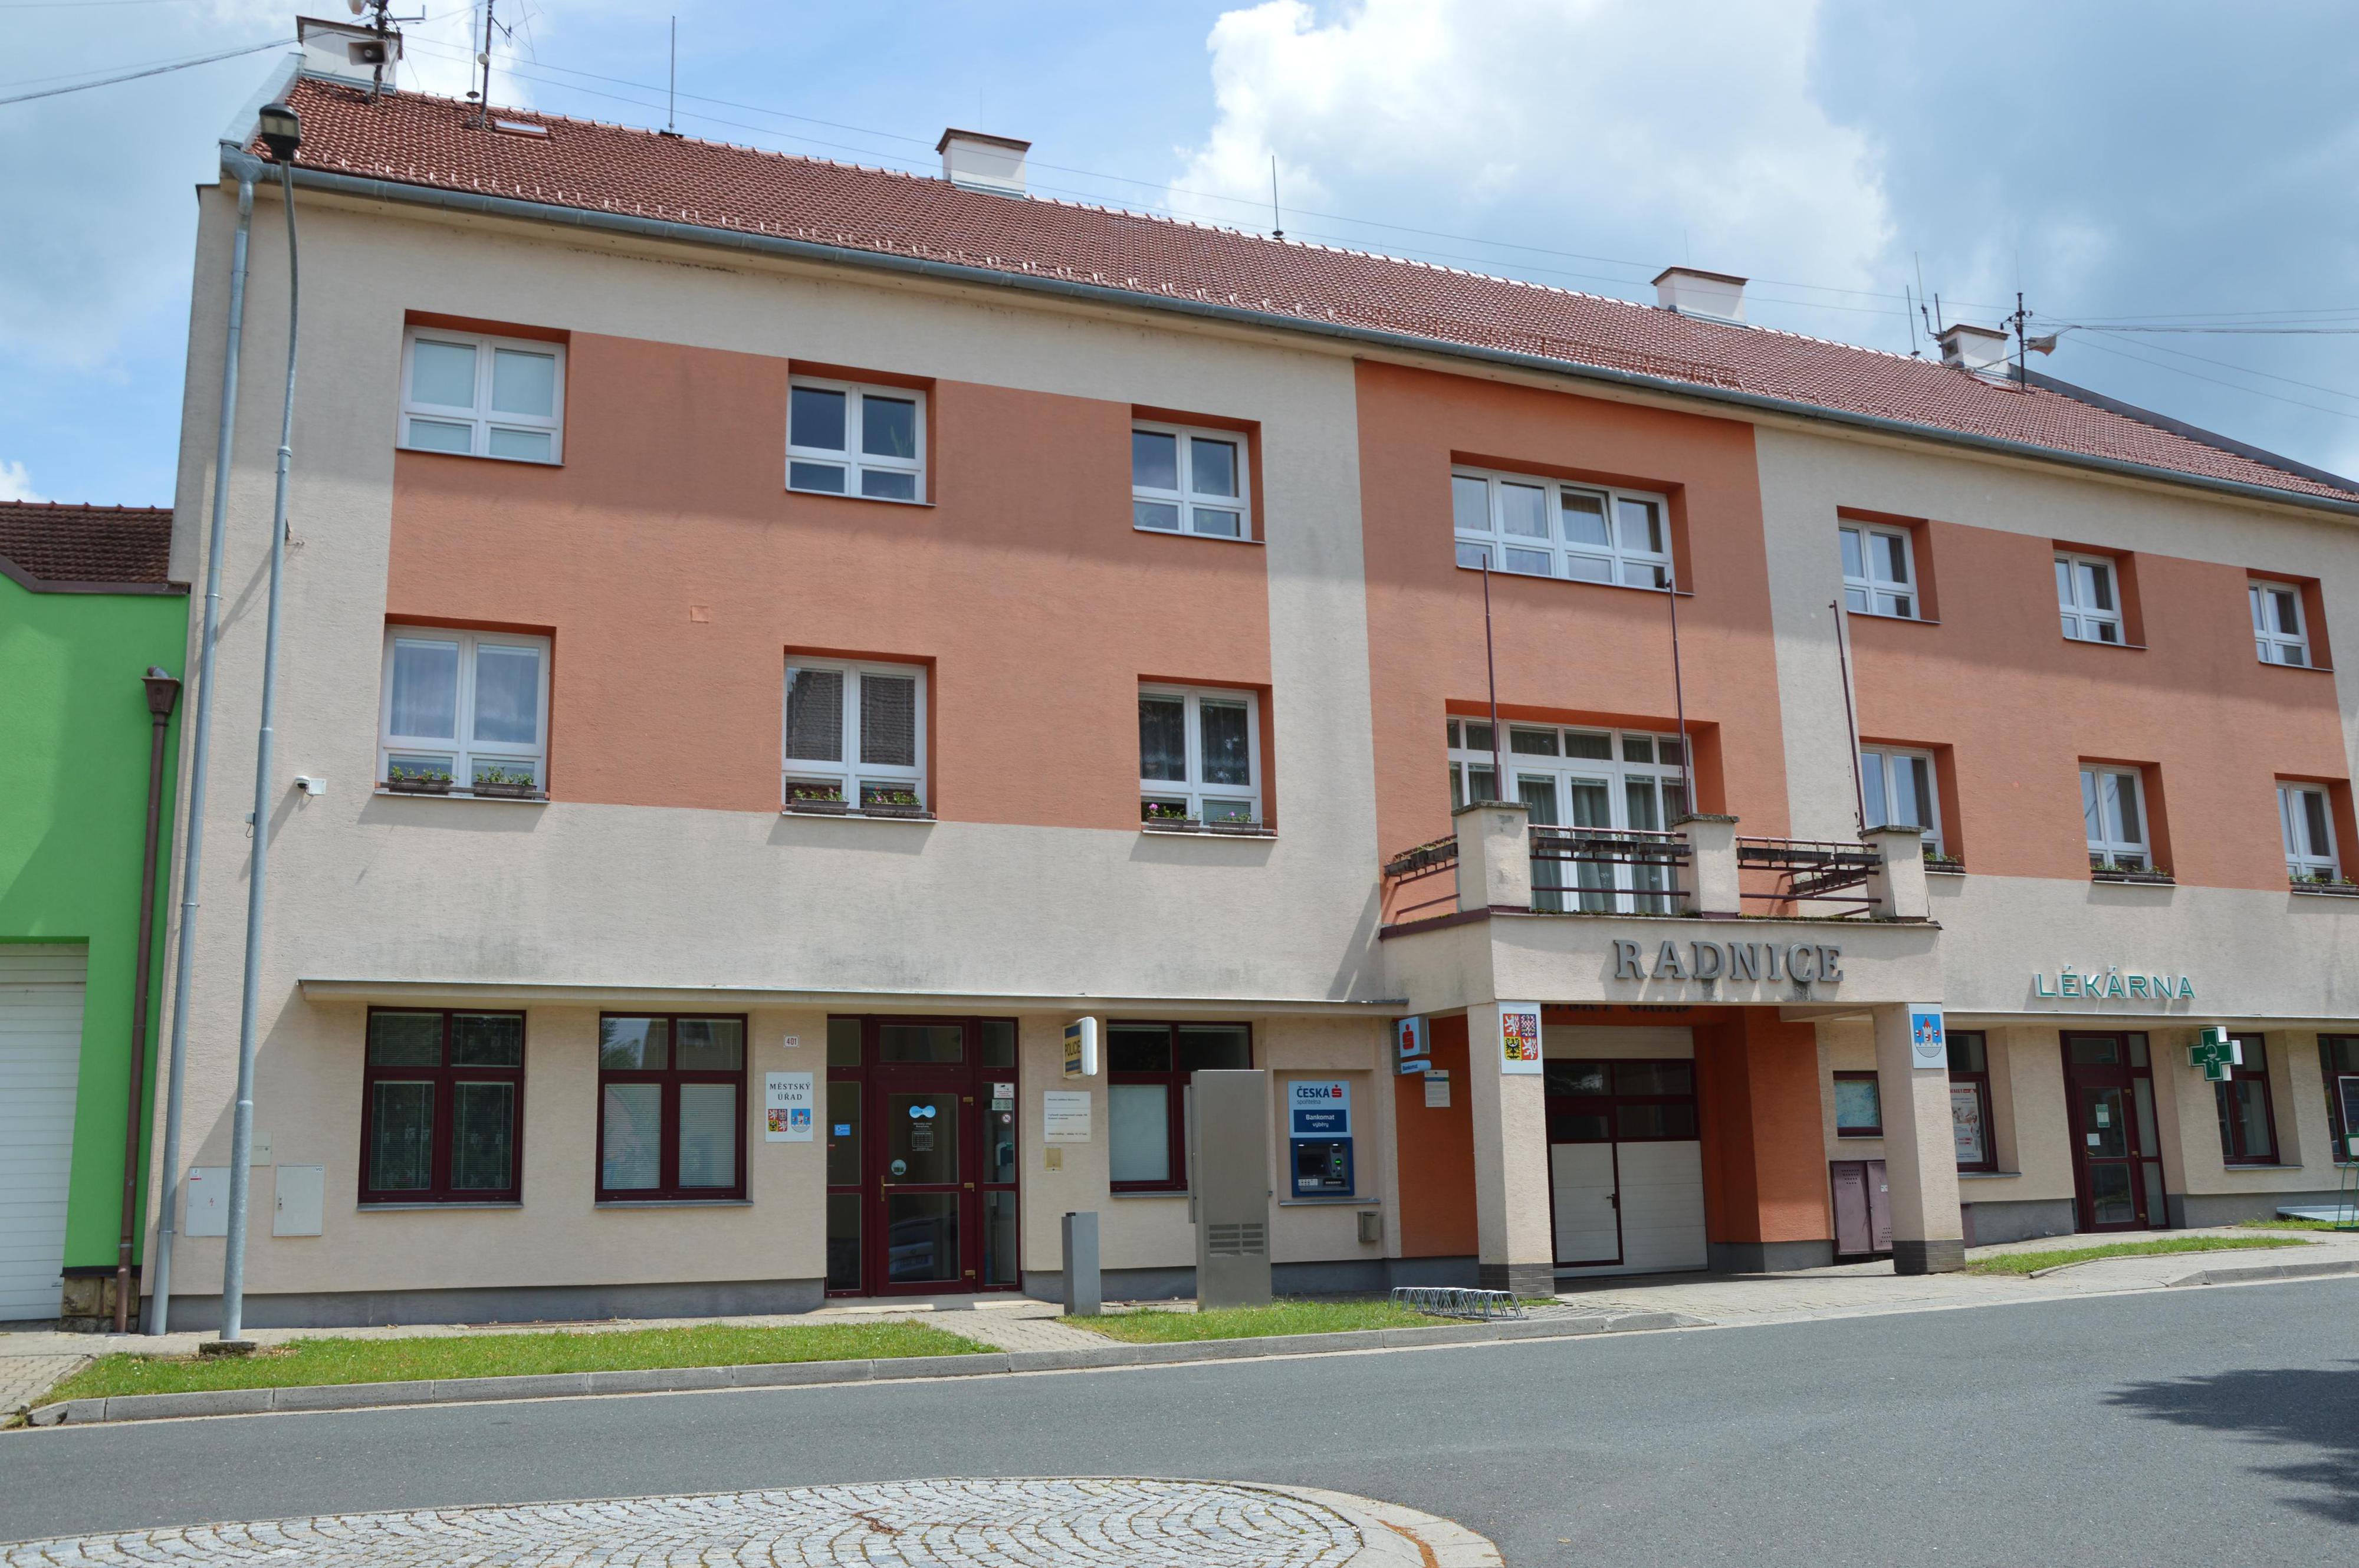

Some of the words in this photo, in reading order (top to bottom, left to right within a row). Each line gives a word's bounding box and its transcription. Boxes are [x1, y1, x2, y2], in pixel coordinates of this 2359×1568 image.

[1613, 939, 1844, 982] RADNICE
[2035, 965, 2196, 999] LÉKÁRNA
[786, 1037, 797, 1046] 401
[1064, 1040, 1081, 1057] POLICIE
[769, 1082, 811, 1090] MĚSTSKÝ
[1296, 1086, 1330, 1098] ČESKÁ
[777, 1092, 803, 1100] ÚŘAD
